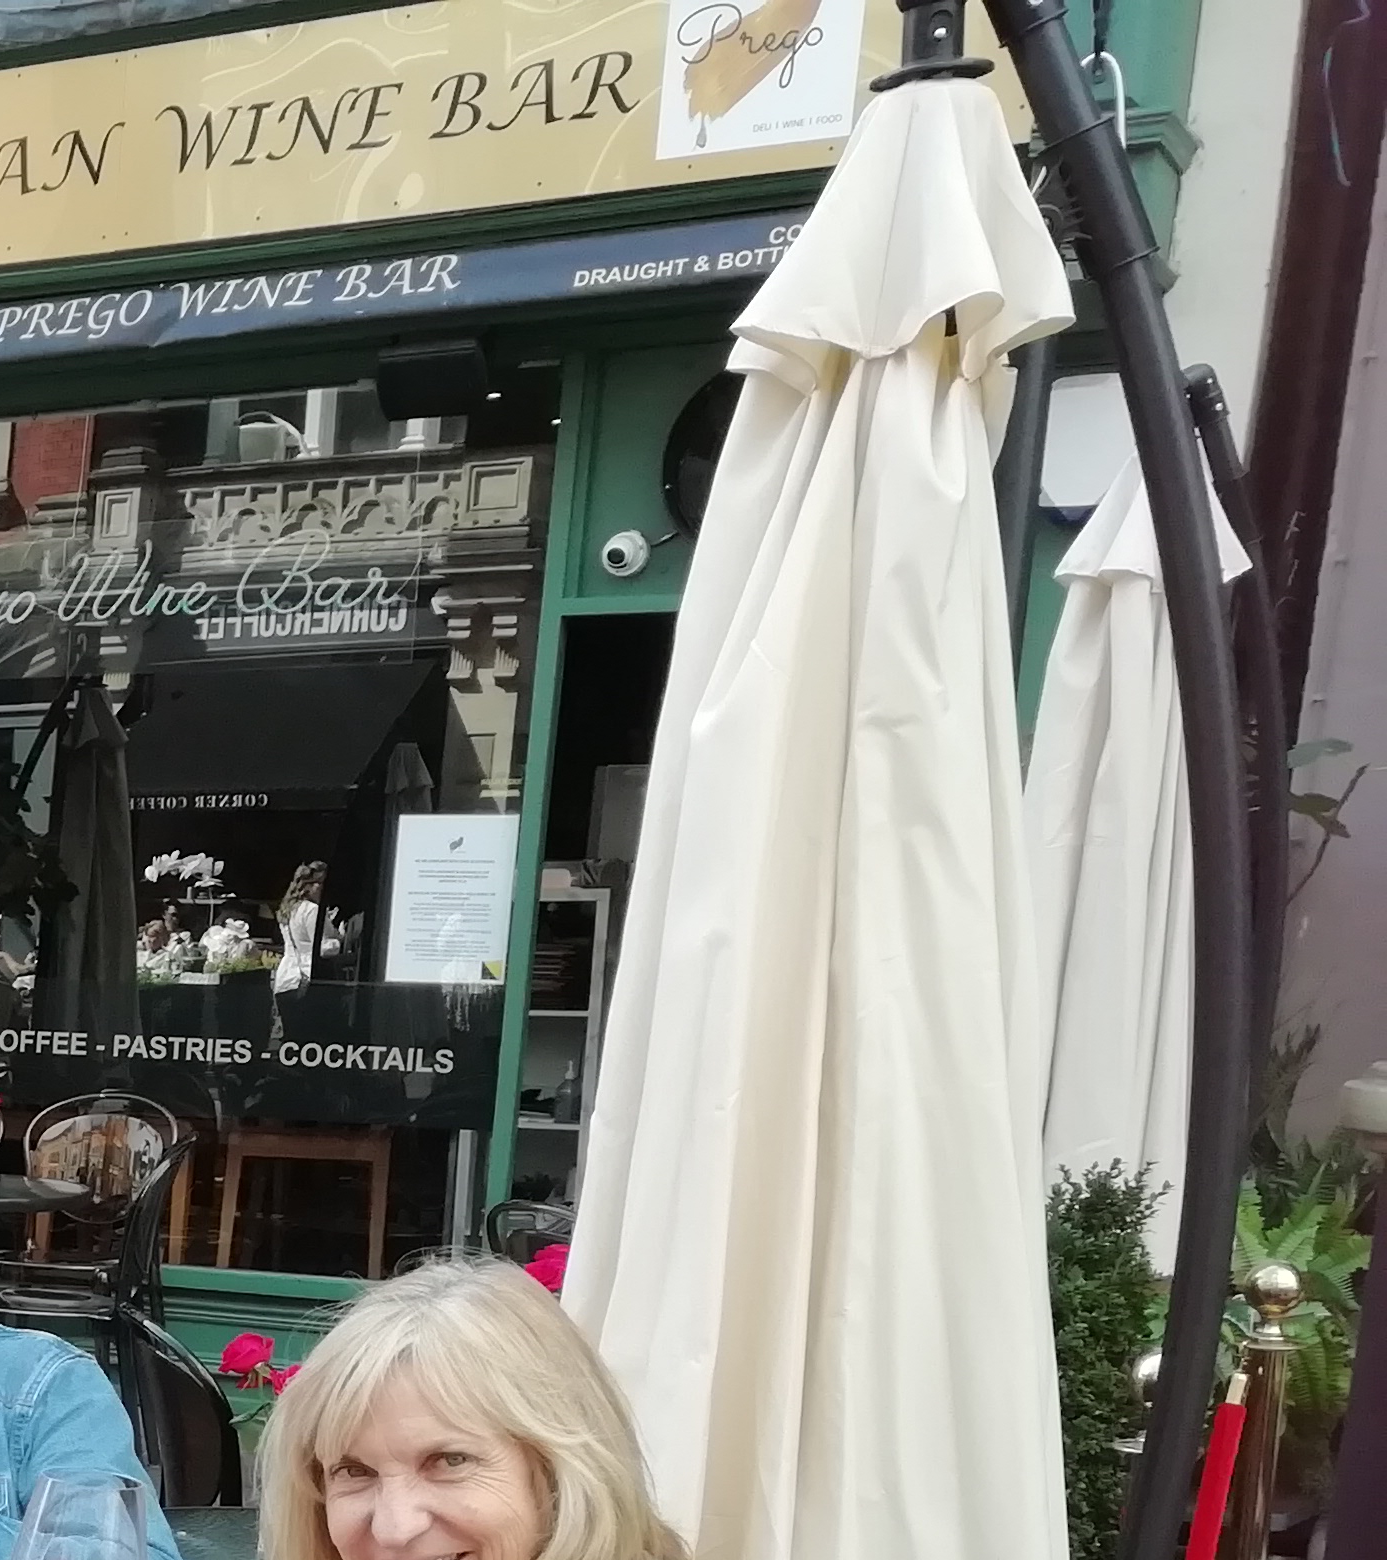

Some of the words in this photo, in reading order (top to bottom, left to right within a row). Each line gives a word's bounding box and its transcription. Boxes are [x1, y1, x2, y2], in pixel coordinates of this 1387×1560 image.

[677, 3, 823, 88] Prego
[155, 82, 404, 173] WINE
[429, 51, 641, 140] BAR
[752, 123, 772, 133] DELI
[782, 120, 804, 129] WINE
[816, 114, 843, 125] FOOD
[168, 269, 323, 319] WINE
[332, 253, 461, 302] BAR
[573, 257, 689, 287] DRAUGHT
[694, 255, 710, 273] &
[58, 539, 217, 622] Wine
[236, 528, 400, 613] Bar
[113, 1035, 252, 1063] PASTRIES
[279, 1041, 454, 1074] COCKTAILS
